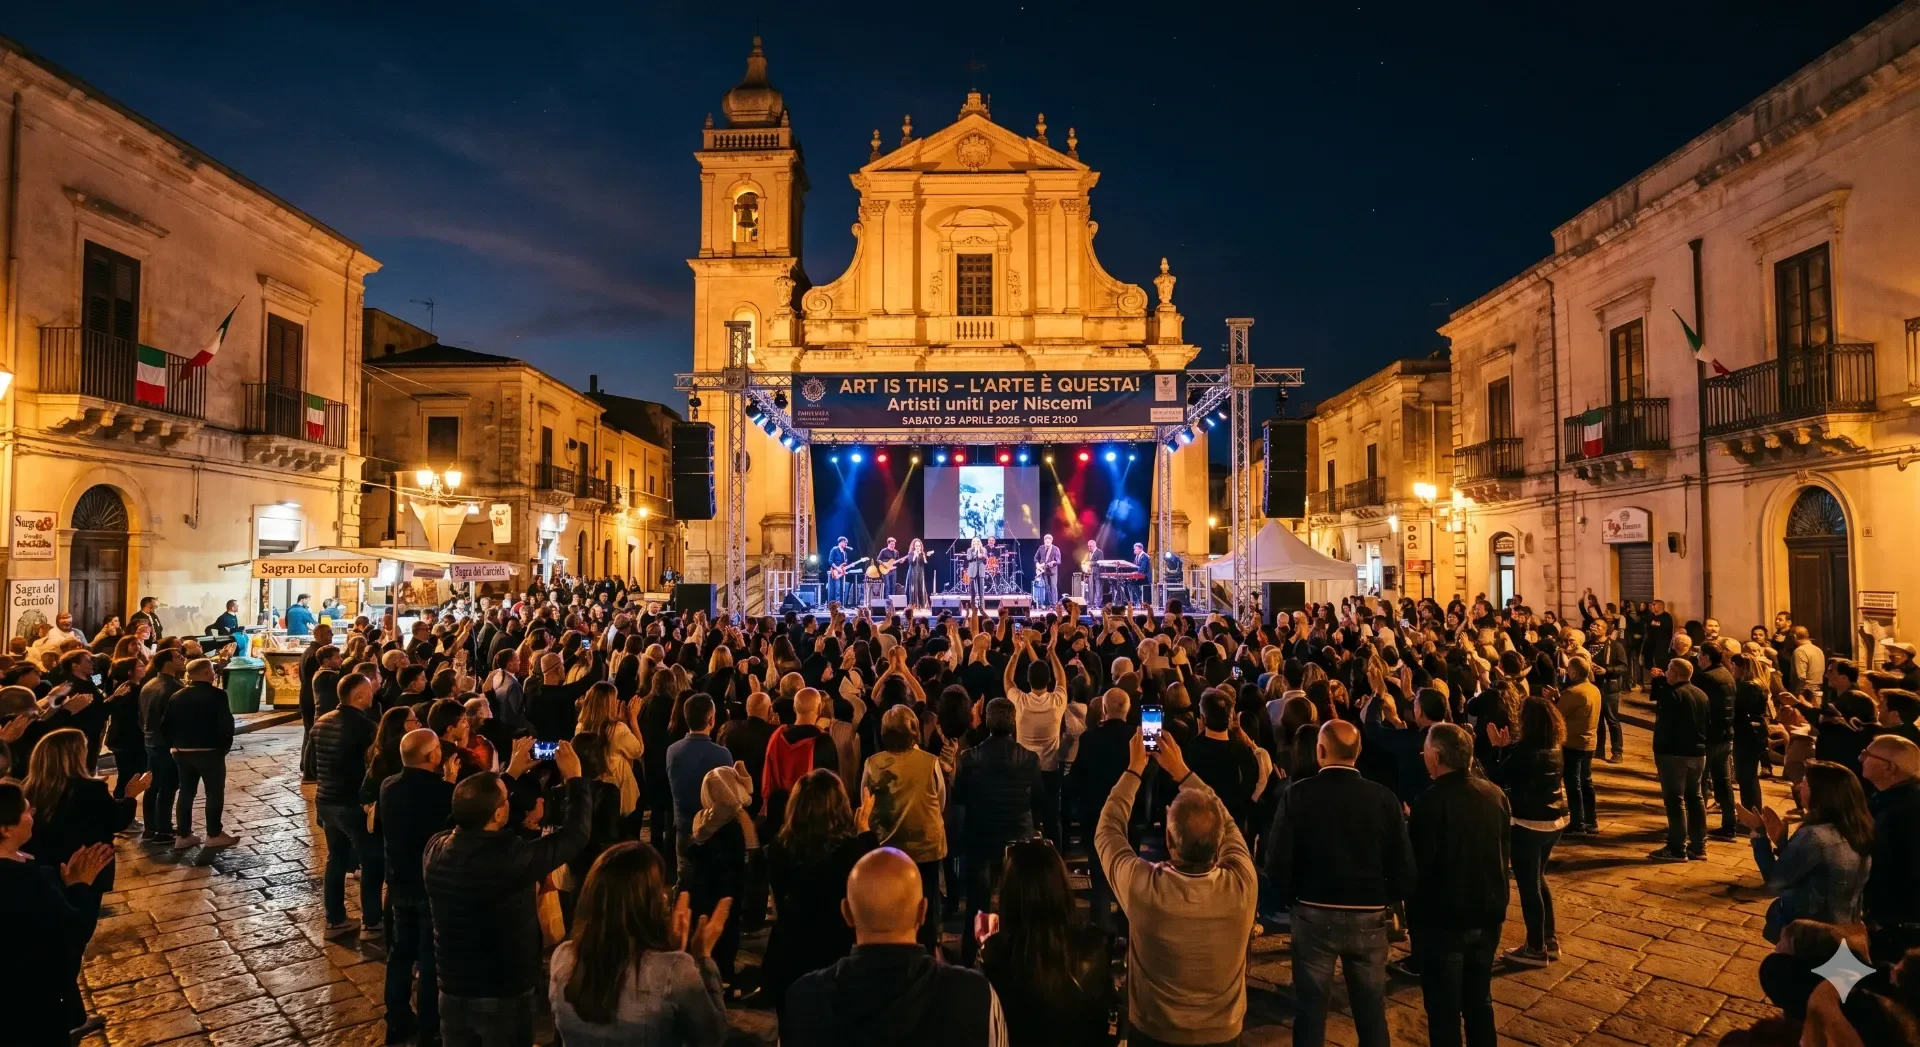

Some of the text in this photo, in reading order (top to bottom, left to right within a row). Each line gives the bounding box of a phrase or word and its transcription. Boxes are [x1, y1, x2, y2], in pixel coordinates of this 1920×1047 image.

[839, 379, 878, 394] ART
[884, 378, 901, 394] IS
[905, 378, 949, 394] THIS
[970, 378, 1035, 393] L'ARTE
[1041, 373, 1053, 393] È
[1057, 377, 1140, 393] QUESTA!
[887, 395, 1092, 414] Artisti uniti per Niscemi
[902, 416, 942, 425] SABATO
[944, 416, 956, 425] 25
[958, 416, 994, 425] APRILE
[995, 415, 1020, 424] 2025
[1029, 415, 1050, 424] ORE
[1052, 415, 1078, 424] 21:00
[261, 562, 369, 577] Sagra Del Carciofo
[15, 583, 55, 597] Sagra del
[14, 595, 54, 607] Carciofo
